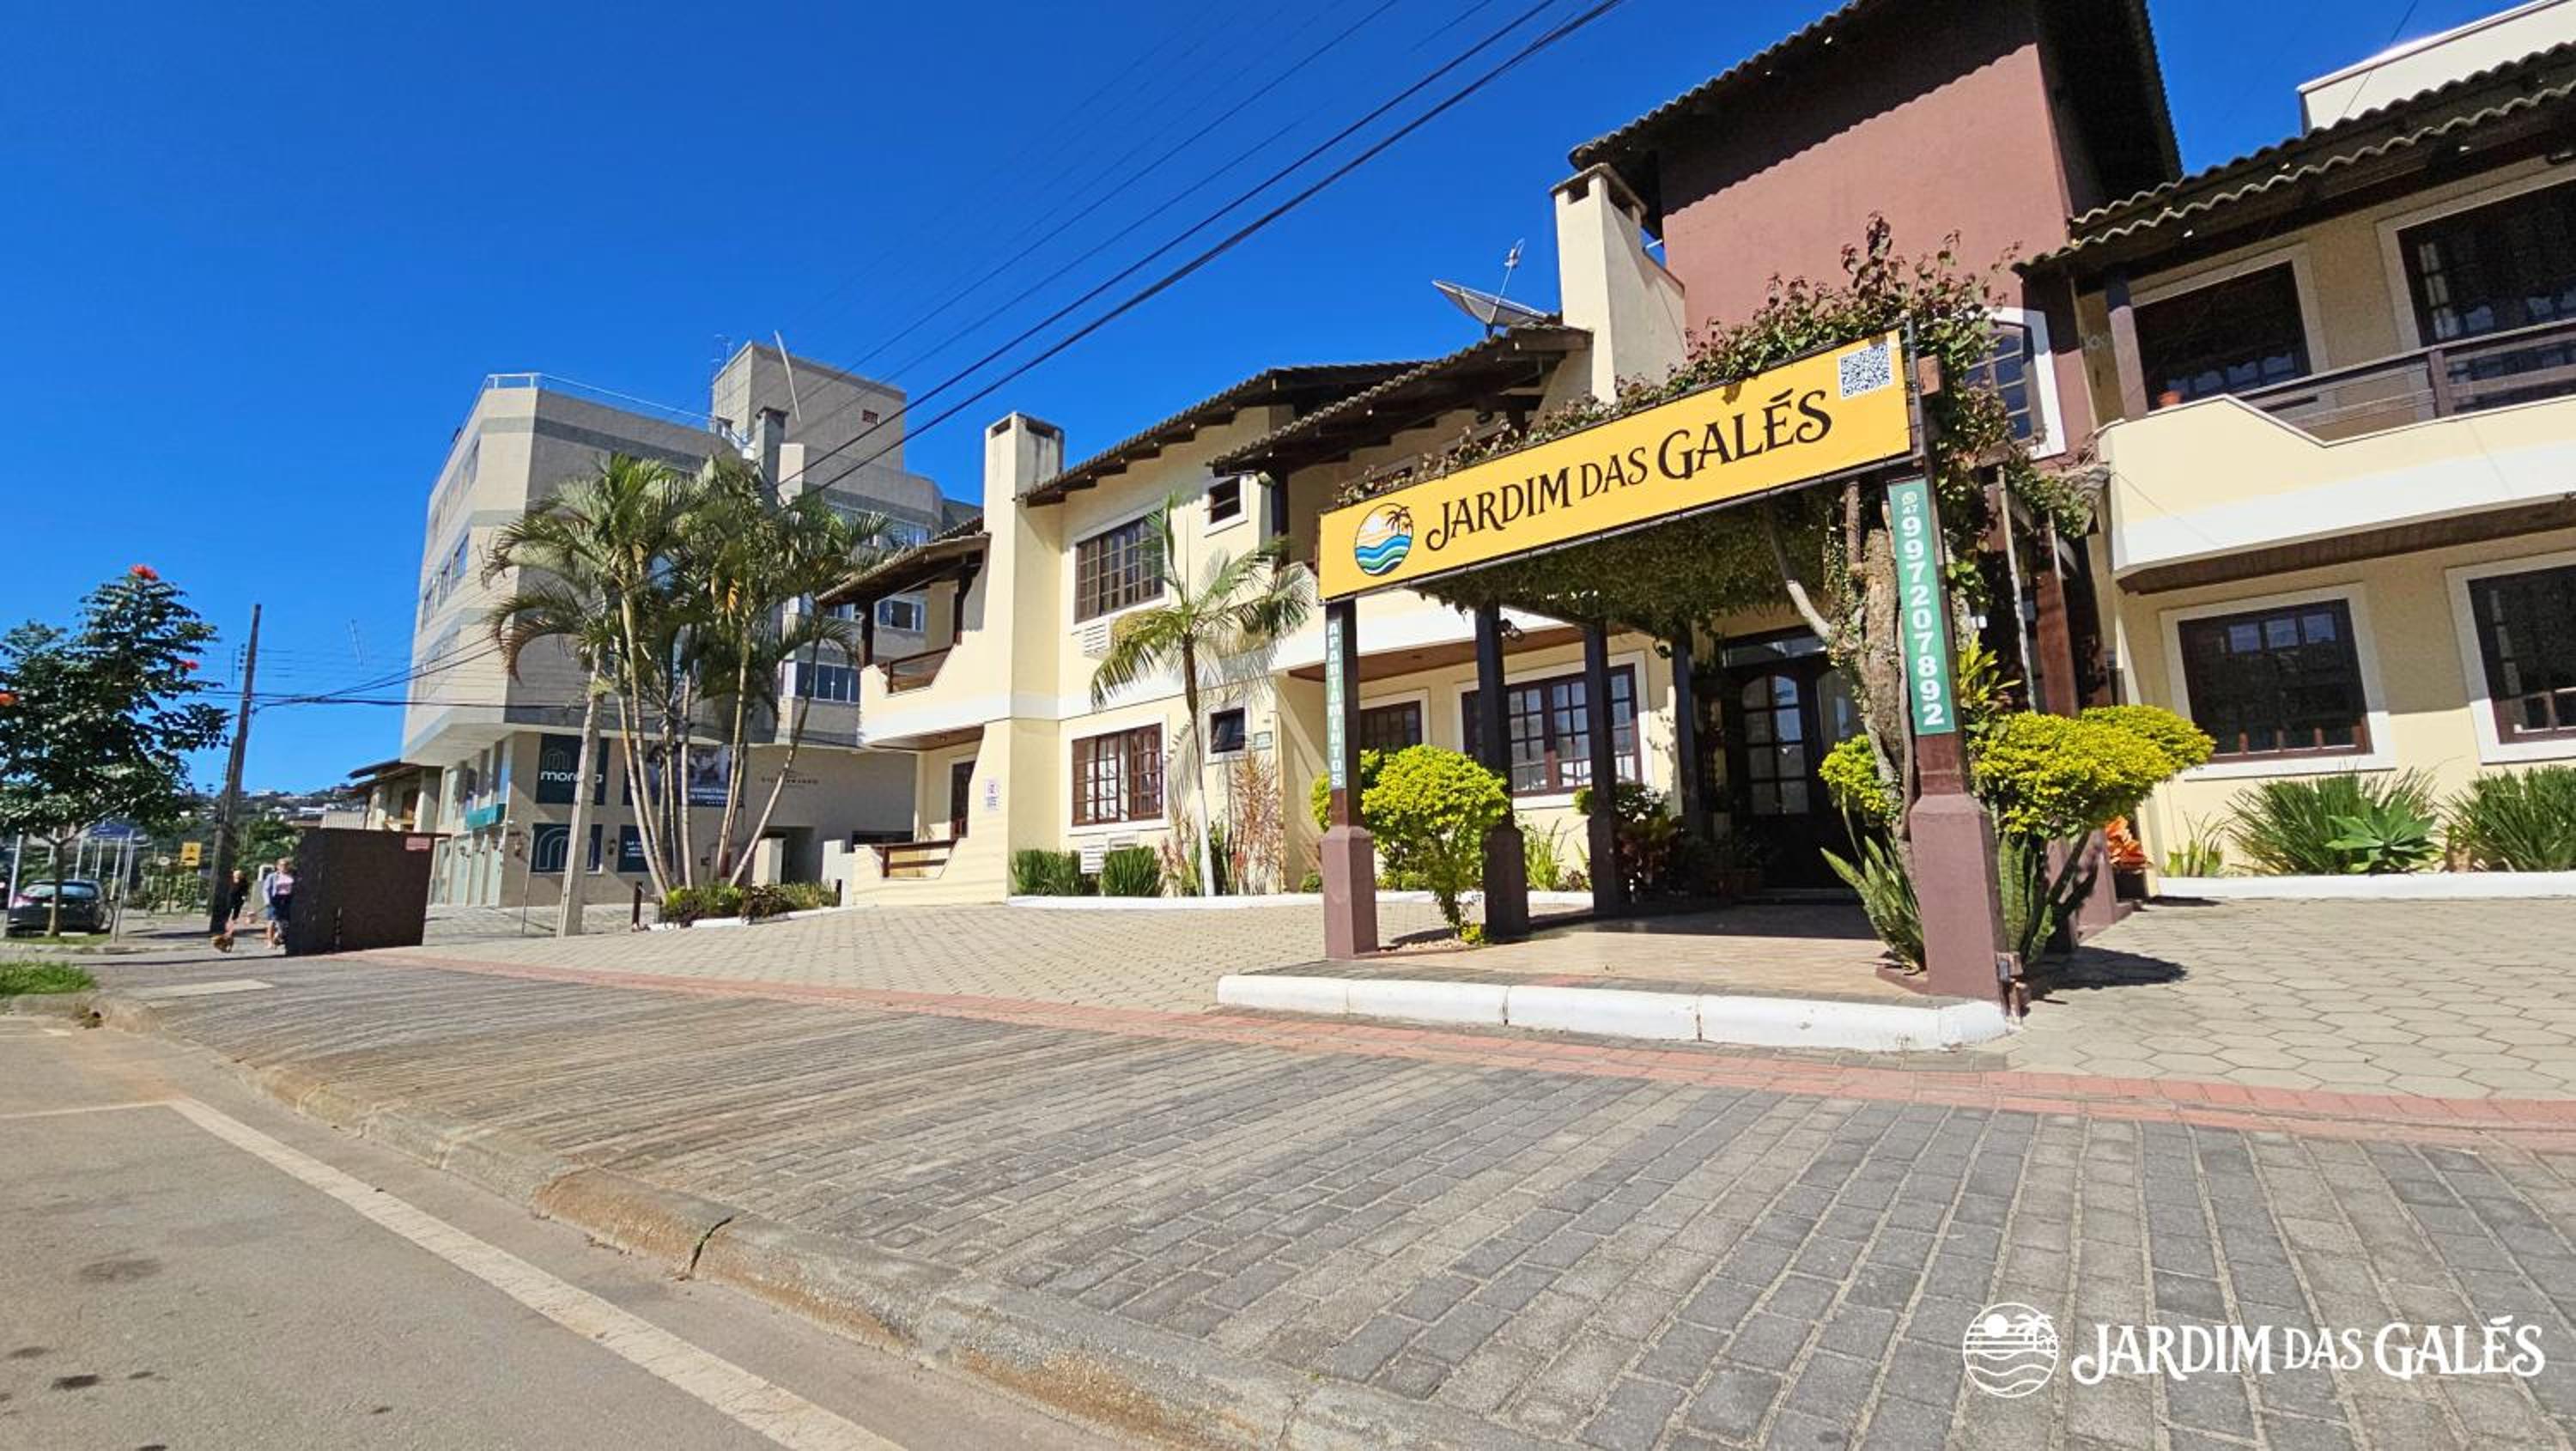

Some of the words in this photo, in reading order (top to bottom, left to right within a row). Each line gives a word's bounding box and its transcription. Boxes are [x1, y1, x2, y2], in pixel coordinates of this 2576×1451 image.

[1425, 466, 1572, 552] JARDIM
[1580, 446, 1648, 499] DAS
[1657, 387, 1832, 480] GALÉS
[1900, 515, 1944, 726] 997207892
[540, 771, 604, 783] mora
[1327, 622, 1342, 786] APARTAMENTOS
